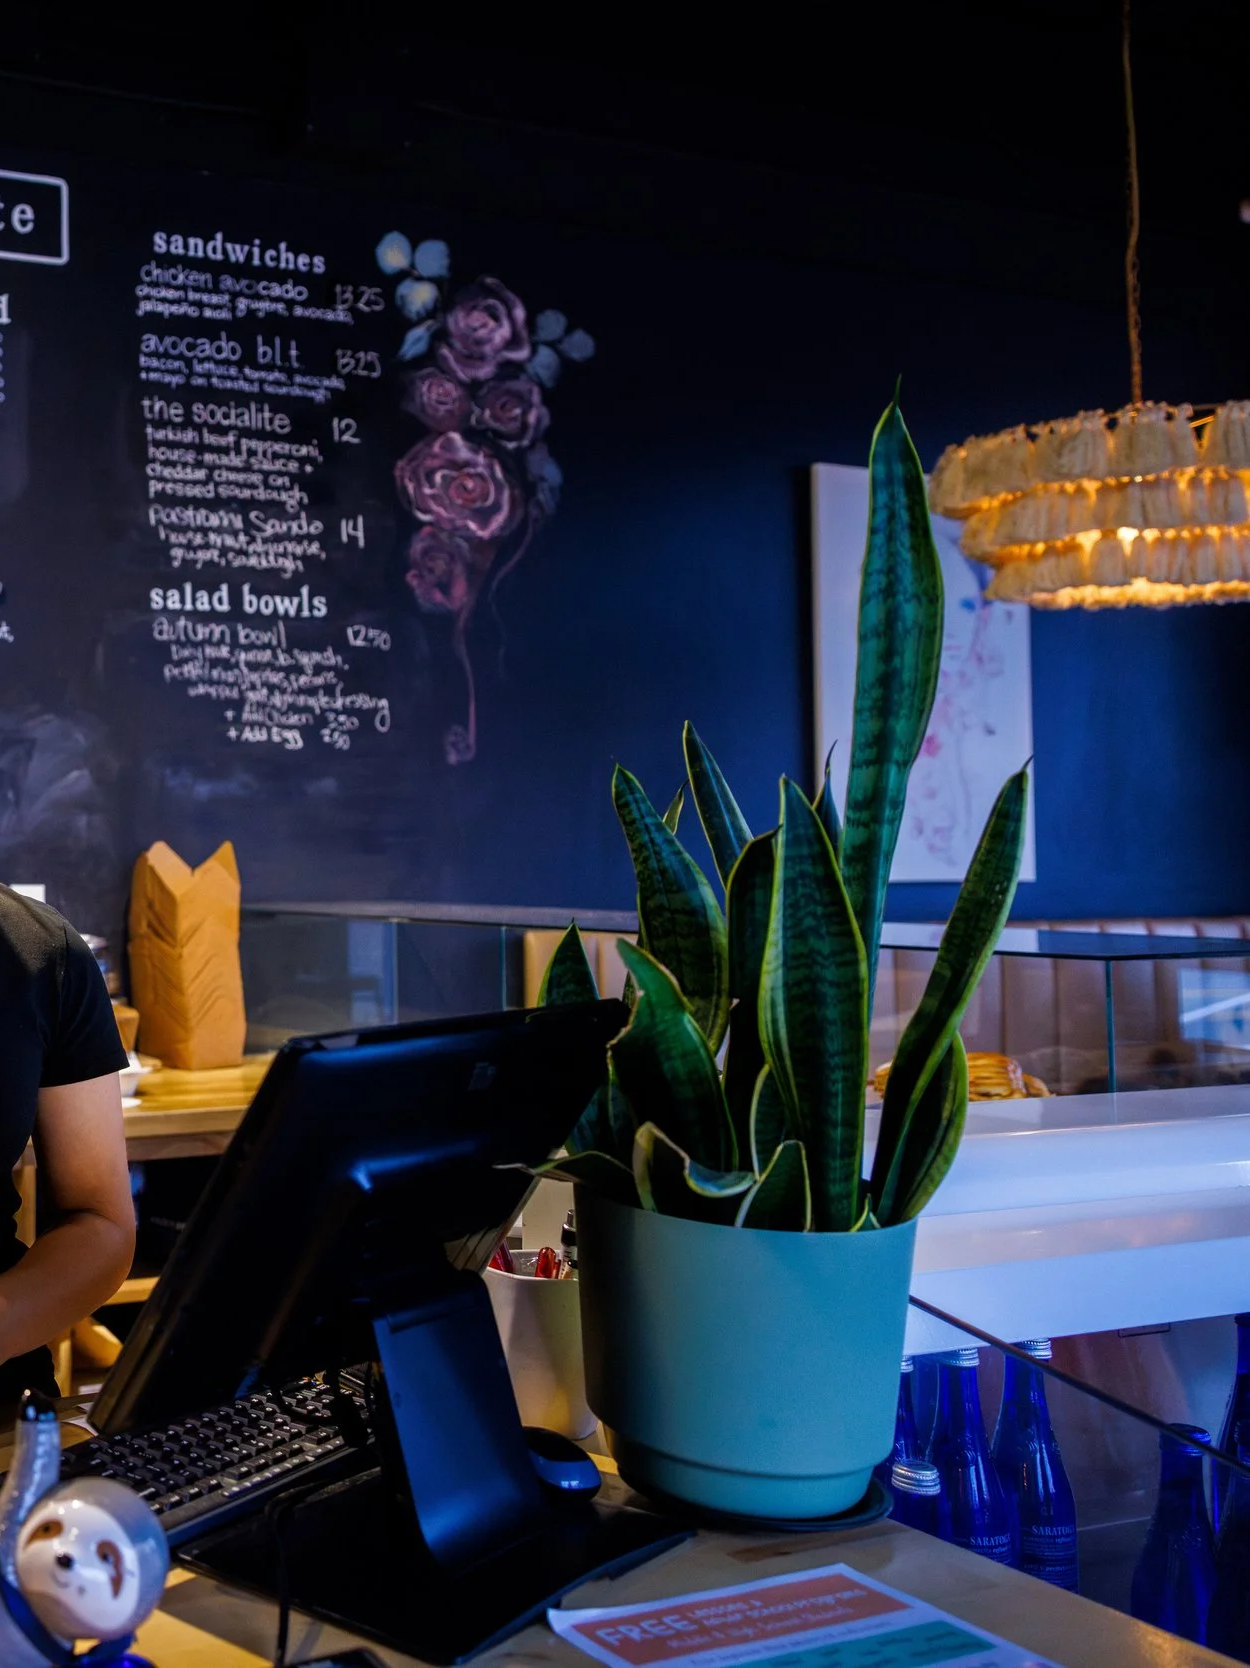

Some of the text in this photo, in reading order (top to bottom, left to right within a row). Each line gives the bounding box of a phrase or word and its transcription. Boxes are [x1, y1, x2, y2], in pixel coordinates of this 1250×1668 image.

[153, 231, 326, 274] sandwiches
[139, 260, 214, 291] chicken
[218, 275, 309, 302] avocado
[140, 331, 243, 362] avocado
[139, 394, 363, 445] the socialite 12
[250, 509, 325, 539] Sando
[340, 514, 366, 550] 14
[149, 580, 330, 619] salad bowls
[594, 1613, 699, 1649] FREE
